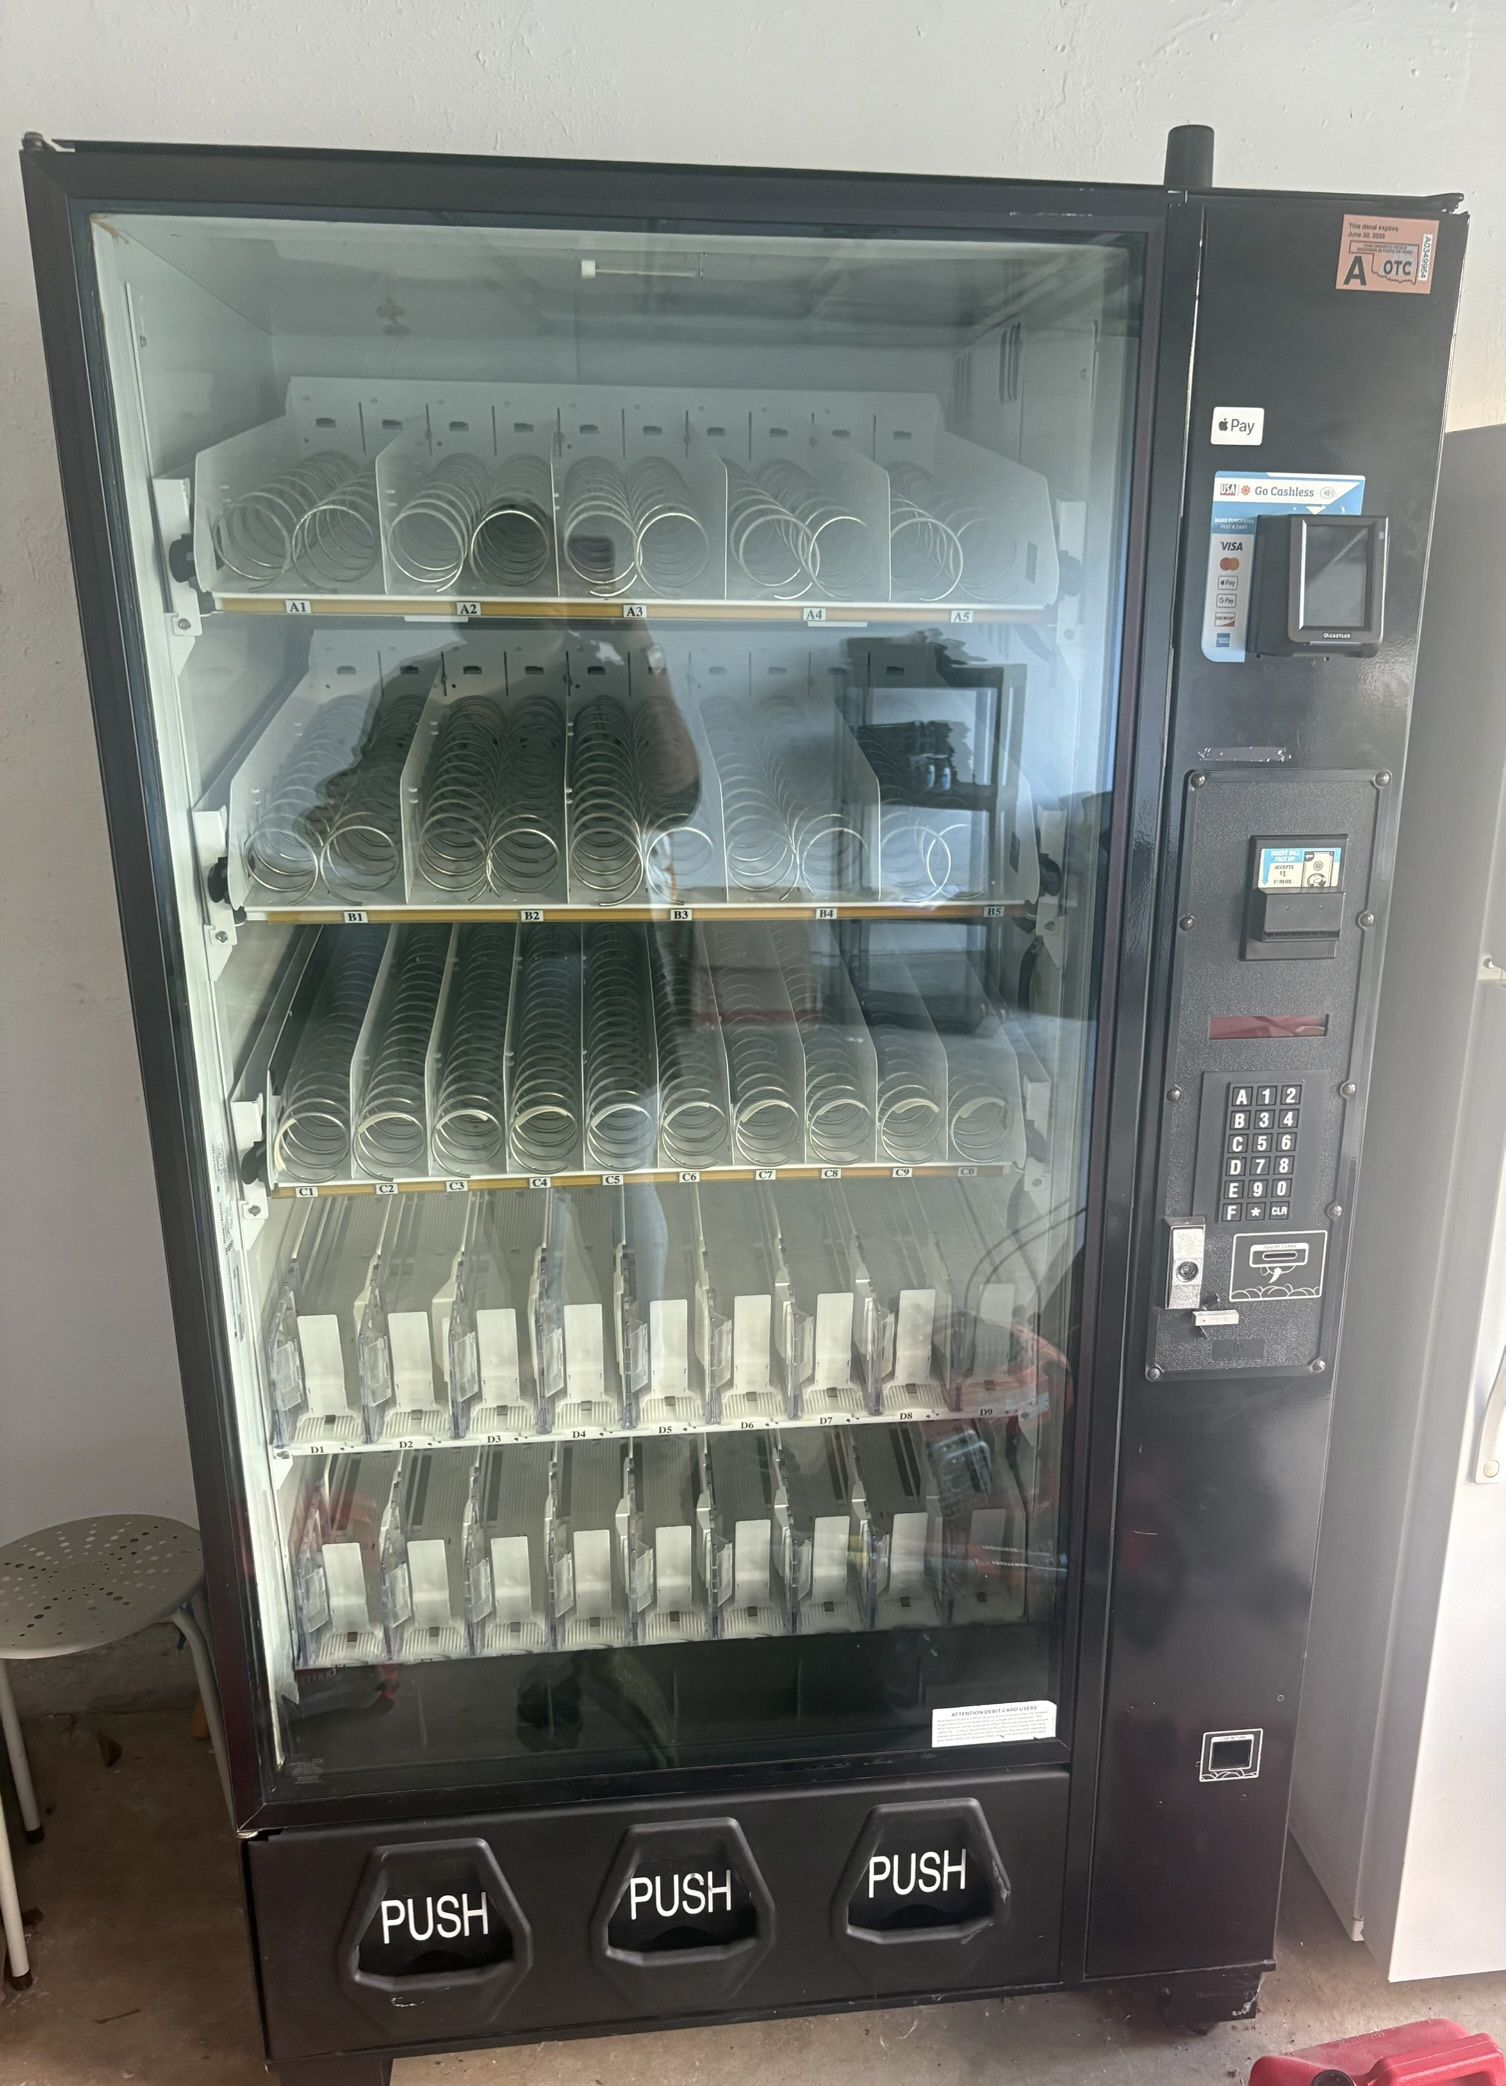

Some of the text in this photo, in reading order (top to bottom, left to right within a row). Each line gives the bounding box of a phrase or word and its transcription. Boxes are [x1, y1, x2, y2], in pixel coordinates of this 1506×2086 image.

[1343, 255, 1367, 286] A
[1383, 260, 1412, 276] OTC
[1231, 419, 1255, 435] Pay
[1220, 483, 1314, 497] USA Go Cashless
[1220, 541, 1243, 551] VISA
[289, 601, 306, 613] A1
[460, 603, 478, 615] A2
[627, 606, 644, 617] A3
[806, 609, 823, 621] A4
[954, 611, 971, 622] A5
[524, 910, 541, 920] B2
[674, 909, 689, 920] B3
[820, 909, 834, 919] B4
[987, 906, 1001, 916] B5
[348, 911, 363, 922] B1
[1235, 1088, 1297, 1105] A 1 2
[1234, 1111, 1294, 1129] B 3 4
[1232, 1135, 1291, 1152] C 5 6
[1230, 1158, 1289, 1175] D 7 8
[682, 1173, 697, 1181] C6
[759, 1171, 773, 1180] C7
[824, 1169, 838, 1177] C8
[895, 1168, 910, 1176] C9
[532, 1178, 548, 1187] C4
[605, 1176, 620, 1185] C5
[379, 1185, 395, 1193] C2
[449, 1182, 465, 1190] C3
[1228, 1181, 1287, 1198] E 9 0
[299, 1188, 314, 1196] C1
[1226, 1205, 1237, 1220] F
[1271, 1206, 1288, 1216] CLR
[900, 1412, 913, 1420] D8
[980, 1408, 993, 1417] D9
[741, 1421, 754, 1430] D6
[819, 1417, 833, 1425] D7
[572, 1431, 587, 1439] D4
[658, 1426, 673, 1434] D5
[399, 1440, 414, 1448] D2
[487, 1435, 502, 1443] D3
[311, 1446, 324, 1454] D1
[868, 1848, 967, 1898] PUSH
[630, 1870, 732, 1919] PUSH
[381, 1892, 489, 1944] PUSH
